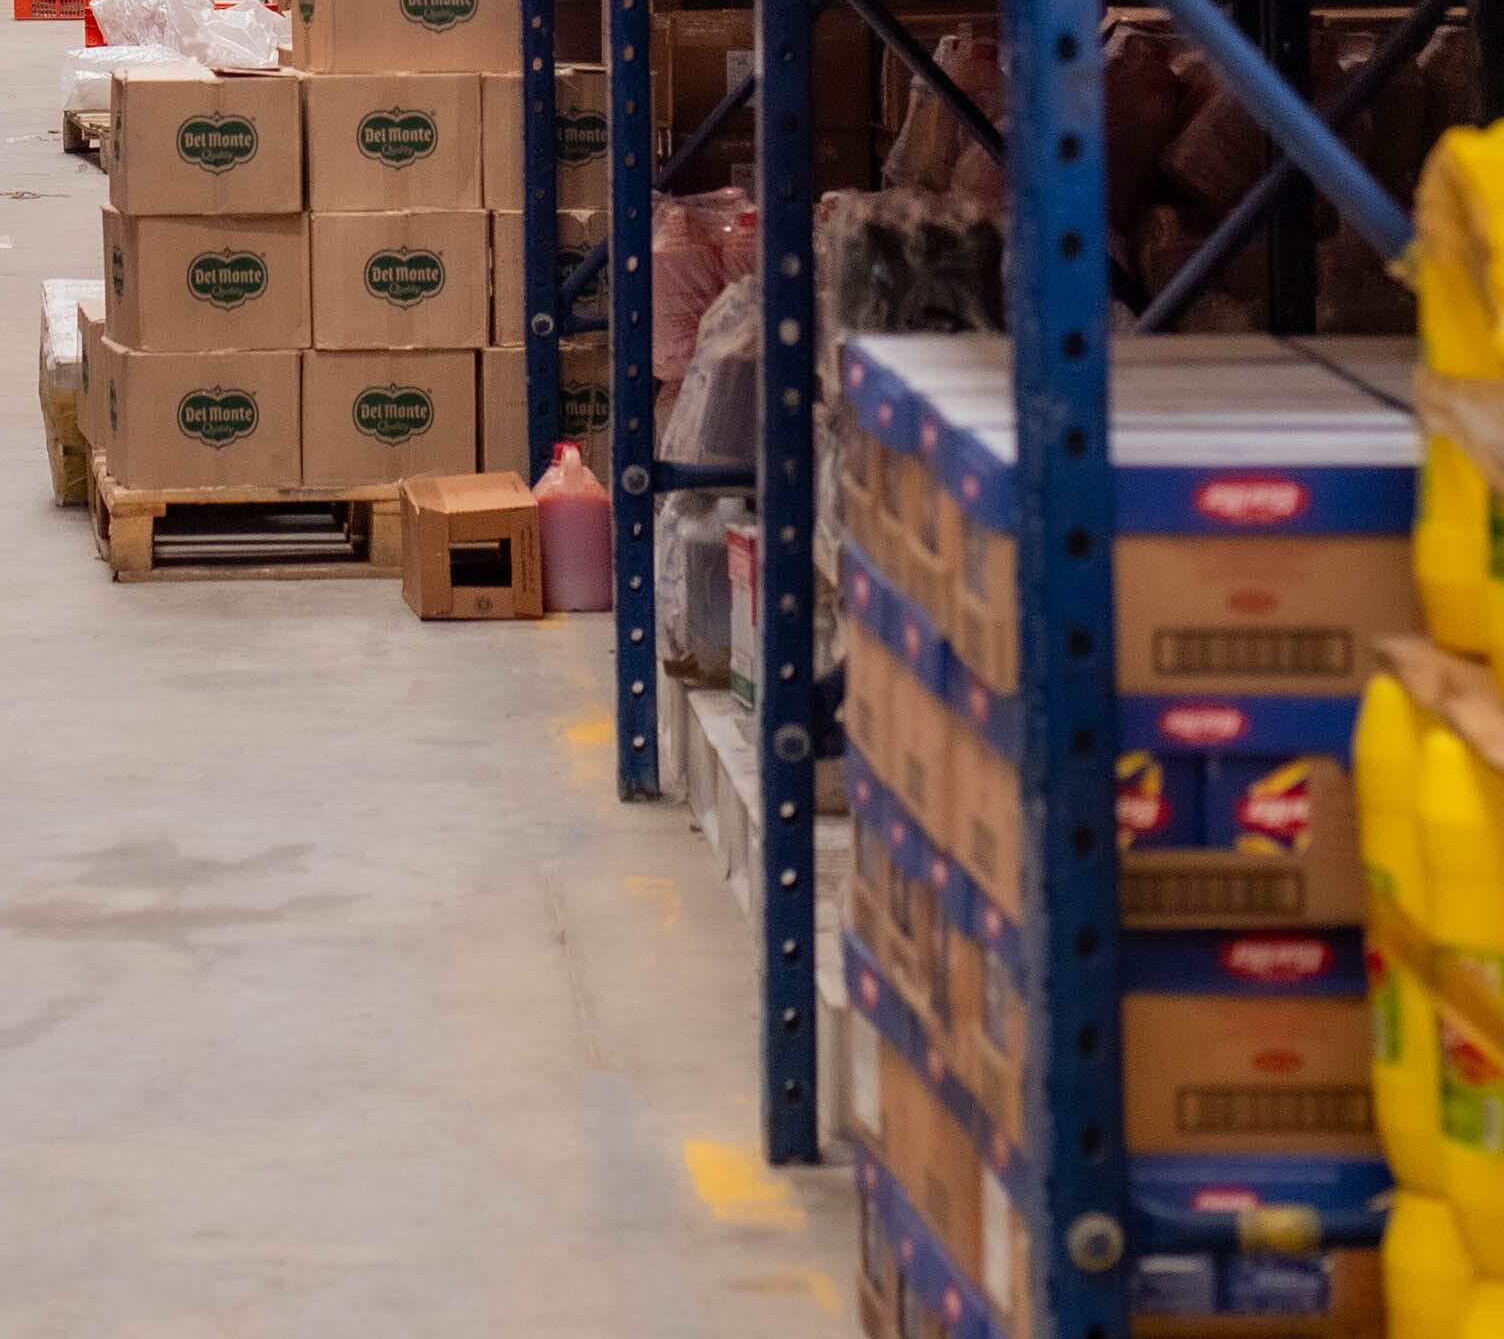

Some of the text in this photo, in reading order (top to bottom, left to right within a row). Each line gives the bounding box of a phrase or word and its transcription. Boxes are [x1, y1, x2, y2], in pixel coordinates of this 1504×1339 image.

[184, 131, 252, 148] Del Monte
[365, 127, 432, 143] Del Monte
[194, 267, 262, 284] Del Monte
[372, 266, 439, 283] Del Monte
[185, 406, 253, 424] Del Monte
[361, 404, 428, 421] Del Monte
